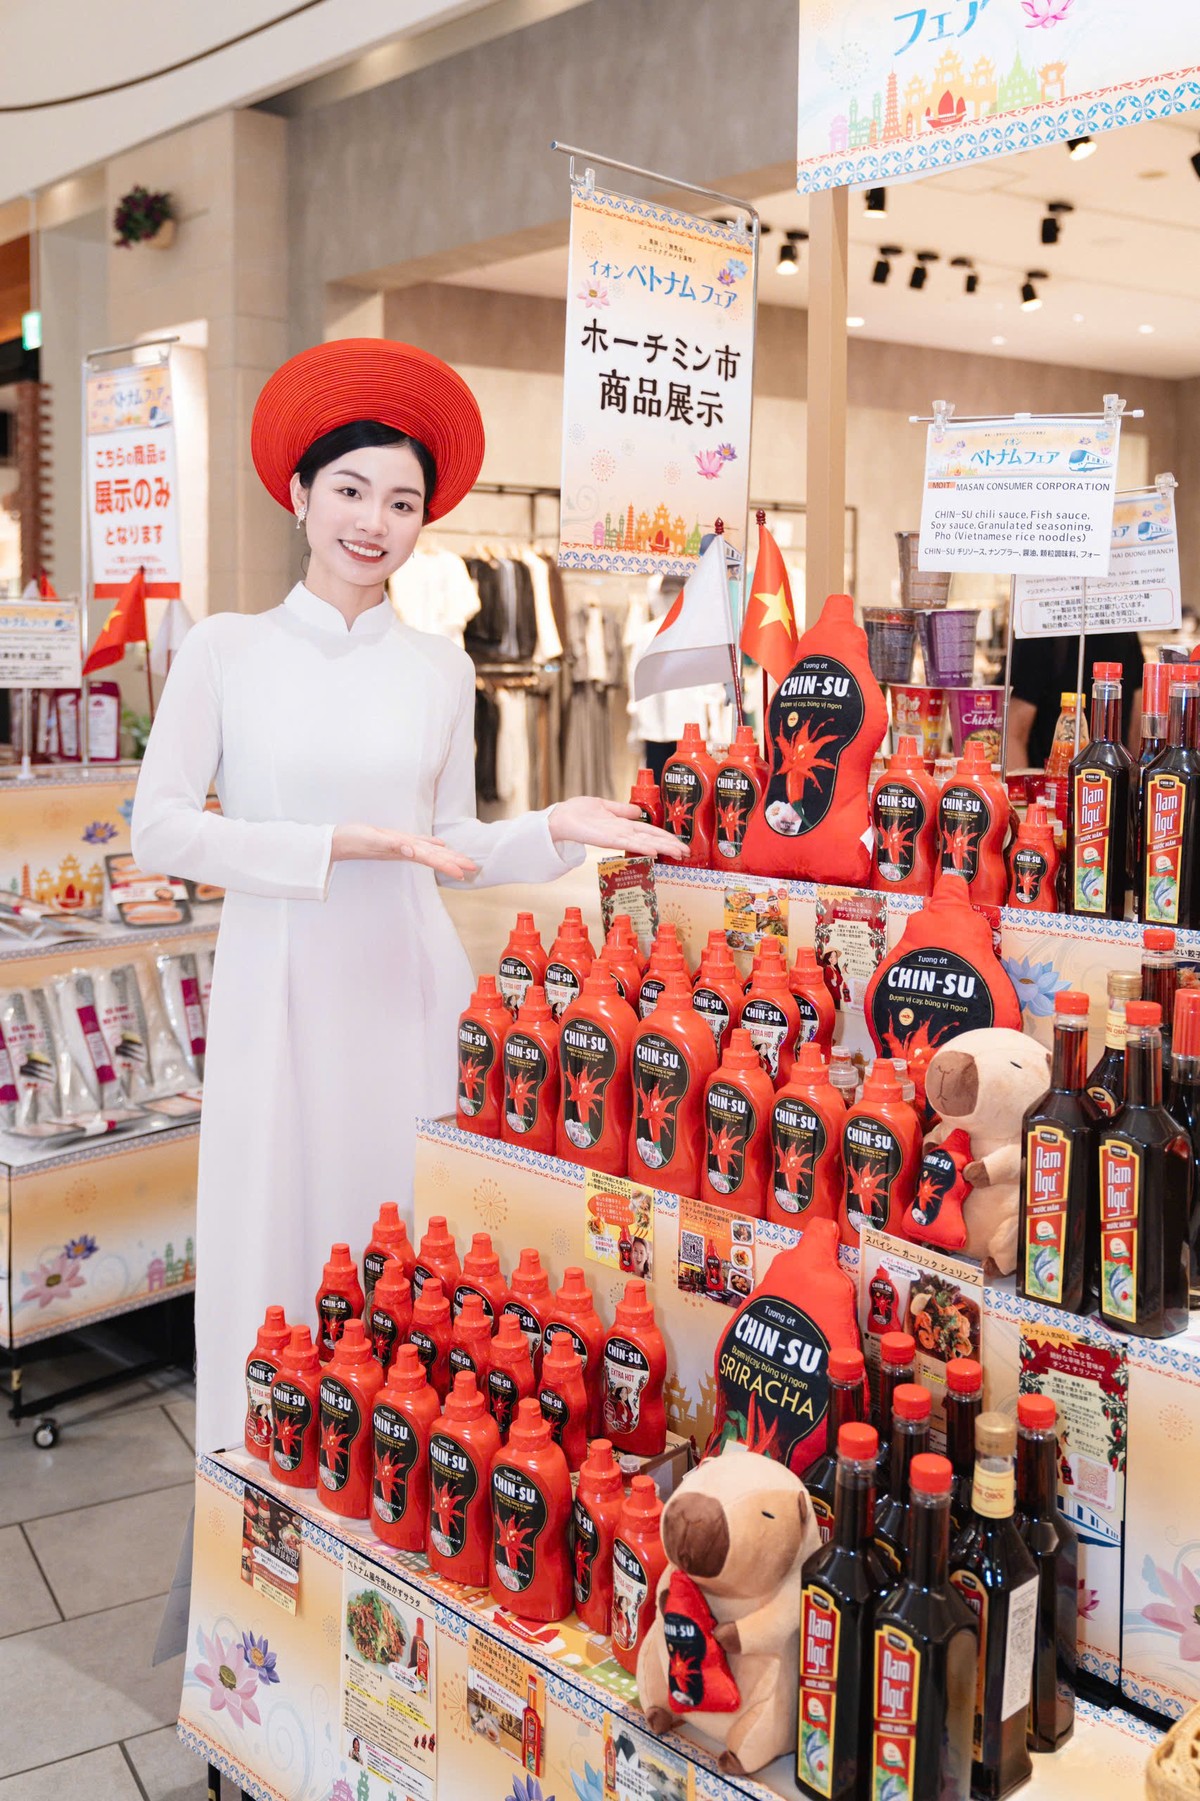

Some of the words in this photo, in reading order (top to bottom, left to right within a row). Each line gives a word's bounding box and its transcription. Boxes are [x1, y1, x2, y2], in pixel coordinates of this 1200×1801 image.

[581, 319, 741, 381] ホーチミン市
[599, 369, 724, 427] 商品展示
[96, 444, 166, 468] こちらの商品は
[970, 448, 1060, 467] ベトナムフェア
[95, 477, 170, 514] 展示のみ
[956, 483, 984, 491] MASAN
[986, 482, 1033, 491] CONSUMER
[1036, 482, 1110, 491] CORPORATION
[935, 510, 973, 519] CHIN-SU
[975, 510, 996, 519] chili
[1031, 510, 1052, 519] Fish
[930, 521, 946, 531] Soy
[978, 520, 1033, 530] Granulated
[106, 525, 163, 546] となります
[935, 531, 952, 540] Pho
[954, 531, 1012, 541] (Vietnamese
[1016, 532, 1036, 541] rice
[1038, 532, 1086, 543] noodles)
[924, 547, 956, 555] CHIN-SU
[1148, 547, 1174, 555] BRANCH
[803, 662, 819, 671] Tương
[779, 675, 851, 698] CHIN-SU
[827, 702, 843, 710] ngon
[664, 772, 697, 786] CHIN-SU
[716, 777, 750, 791] CHIN-SU
[877, 795, 916, 809] CHIN-SU
[1082, 787, 1104, 805] Nam
[1155, 793, 1178, 811] Nam
[942, 798, 981, 813] CHIN-SU
[1016, 853, 1042, 864] CHIN-SU
[918, 955, 937, 965] Tương
[938, 955, 948, 965] ớt
[500, 963, 528, 977] CHIN-SU
[546, 970, 574, 984] CHIN-SU
[887, 965, 976, 999] CHIN-SU
[692, 994, 723, 1011] CHIN-SU
[950, 1003, 968, 1013] ngon
[745, 1006, 781, 1022] CHIN-SU
[459, 1028, 487, 1047] CHIN-SU
[564, 1029, 606, 1052] CHIN-SU
[506, 1043, 539, 1060] CHIN-SU
[636, 1045, 679, 1069] CHIN-SU
[708, 1090, 747, 1114] CHIN-SU
[774, 1107, 817, 1130] CHIN-SU
[847, 1126, 893, 1150] CHIN-SU
[923, 1154, 952, 1171] CHIN-SU
[1036, 1146, 1061, 1169] Nam
[1107, 1161, 1131, 1185] Nam
[866, 1235, 899, 1254] スパイシー
[902, 1249, 937, 1269] ガーリック
[940, 1263, 979, 1283] シュリンプ
[321, 1299, 347, 1309] CHIN-SU
[373, 1313, 393, 1328] CHIN-SU
[764, 1305, 787, 1325] Tương
[786, 1315, 796, 1327] ớt
[410, 1334, 433, 1350] CHIN-SU
[734, 1312, 823, 1375] CHIN-SU
[450, 1352, 471, 1367] CHIN-SU
[607, 1343, 643, 1366] CHIN-SU
[249, 1365, 272, 1382] CHIN-S
[610, 1367, 623, 1380] EXTRA
[624, 1372, 635, 1383] HOT
[1052, 1361, 1071, 1372] チンス
[1071, 1366, 1104, 1380] チリソース
[490, 1373, 512, 1389] CHIN-SU
[719, 1353, 814, 1422] SRIRACHA
[788, 1375, 809, 1391] ngon
[273, 1386, 306, 1407] CHIN-SU
[320, 1384, 352, 1412] CHIN-SU
[540, 1392, 562, 1409] CHIN-SU
[373, 1413, 409, 1440] CHIN-SU
[430, 1442, 468, 1471] CHIN-SU
[493, 1473, 536, 1504] CHIN-SU
[347, 1559, 422, 1608] ベトナム風牛肉おかずサラダ
[807, 1608, 832, 1640] Nam
[882, 1650, 910, 1682] Nam
